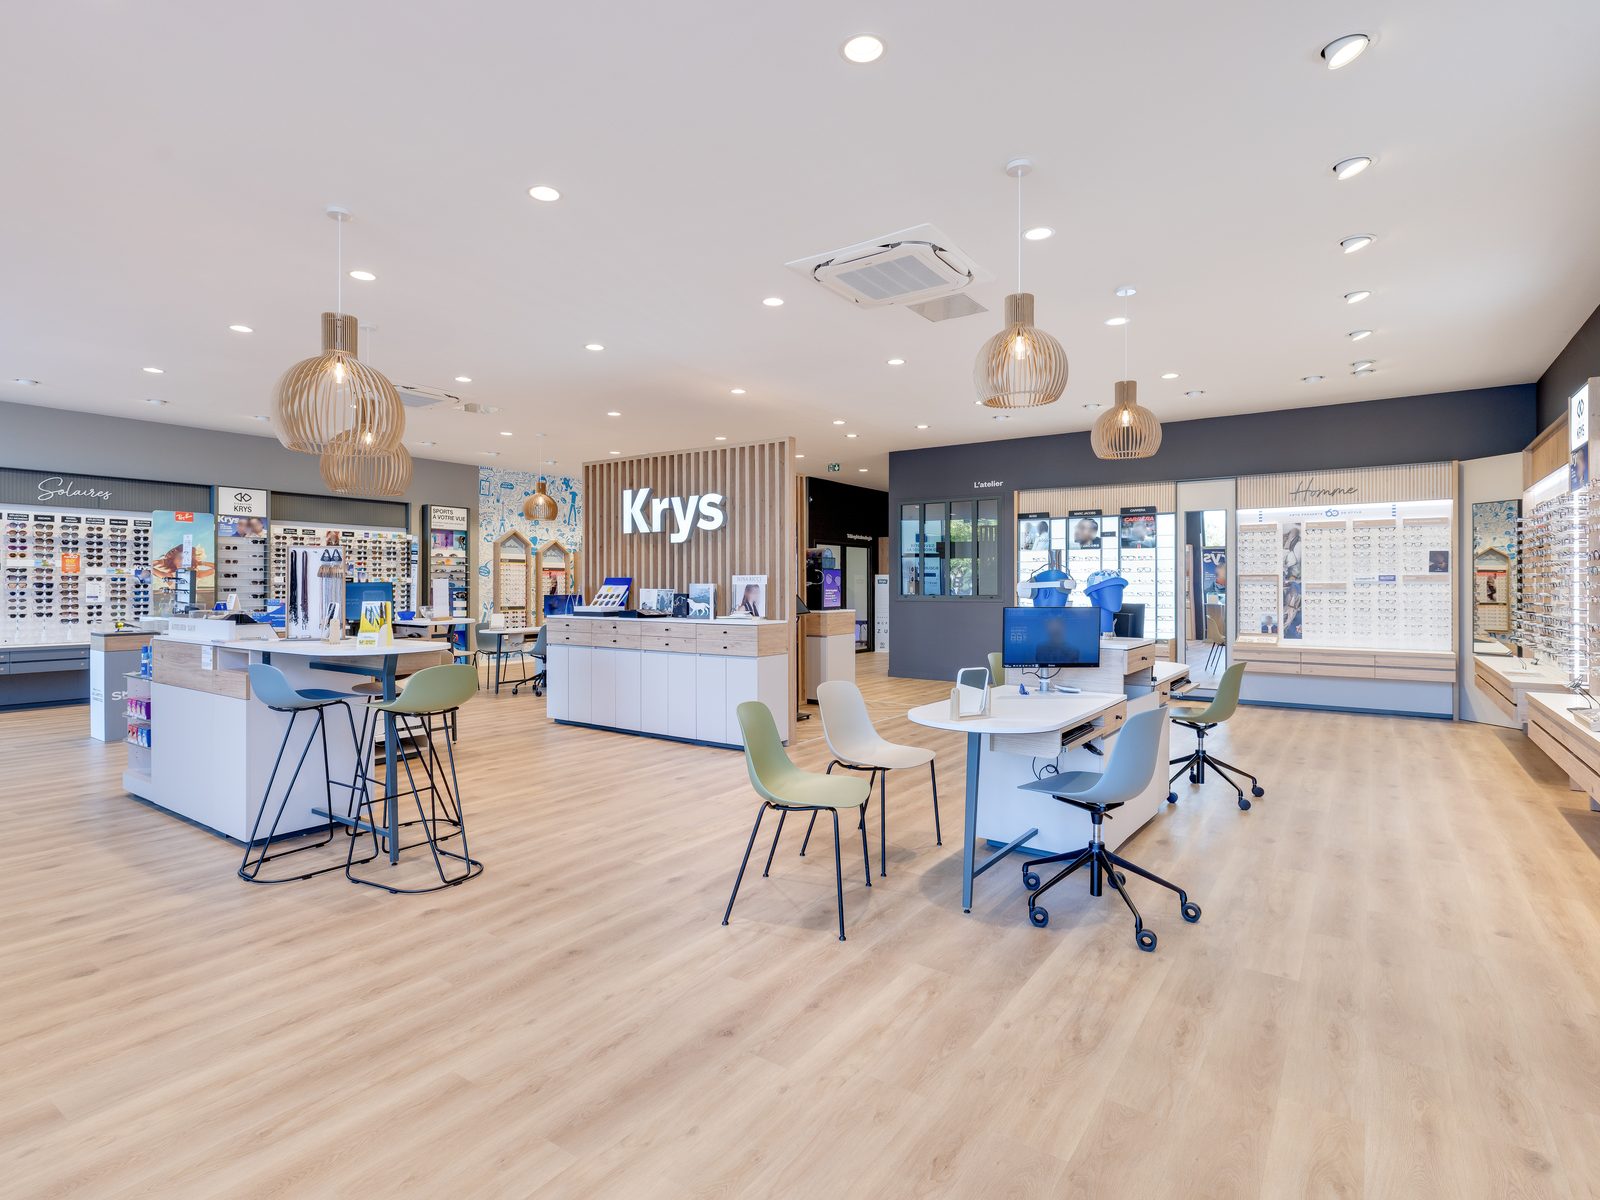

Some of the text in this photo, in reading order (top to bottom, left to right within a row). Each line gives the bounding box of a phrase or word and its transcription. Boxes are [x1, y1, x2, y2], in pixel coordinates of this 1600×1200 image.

[37, 476, 112, 501] Solaires
[974, 480, 1004, 489] L'atelier
[1289, 477, 1358, 502] Homme
[233, 505, 252, 513] KRYS
[623, 488, 725, 543] Krys
[217, 515, 240, 525] Krys
